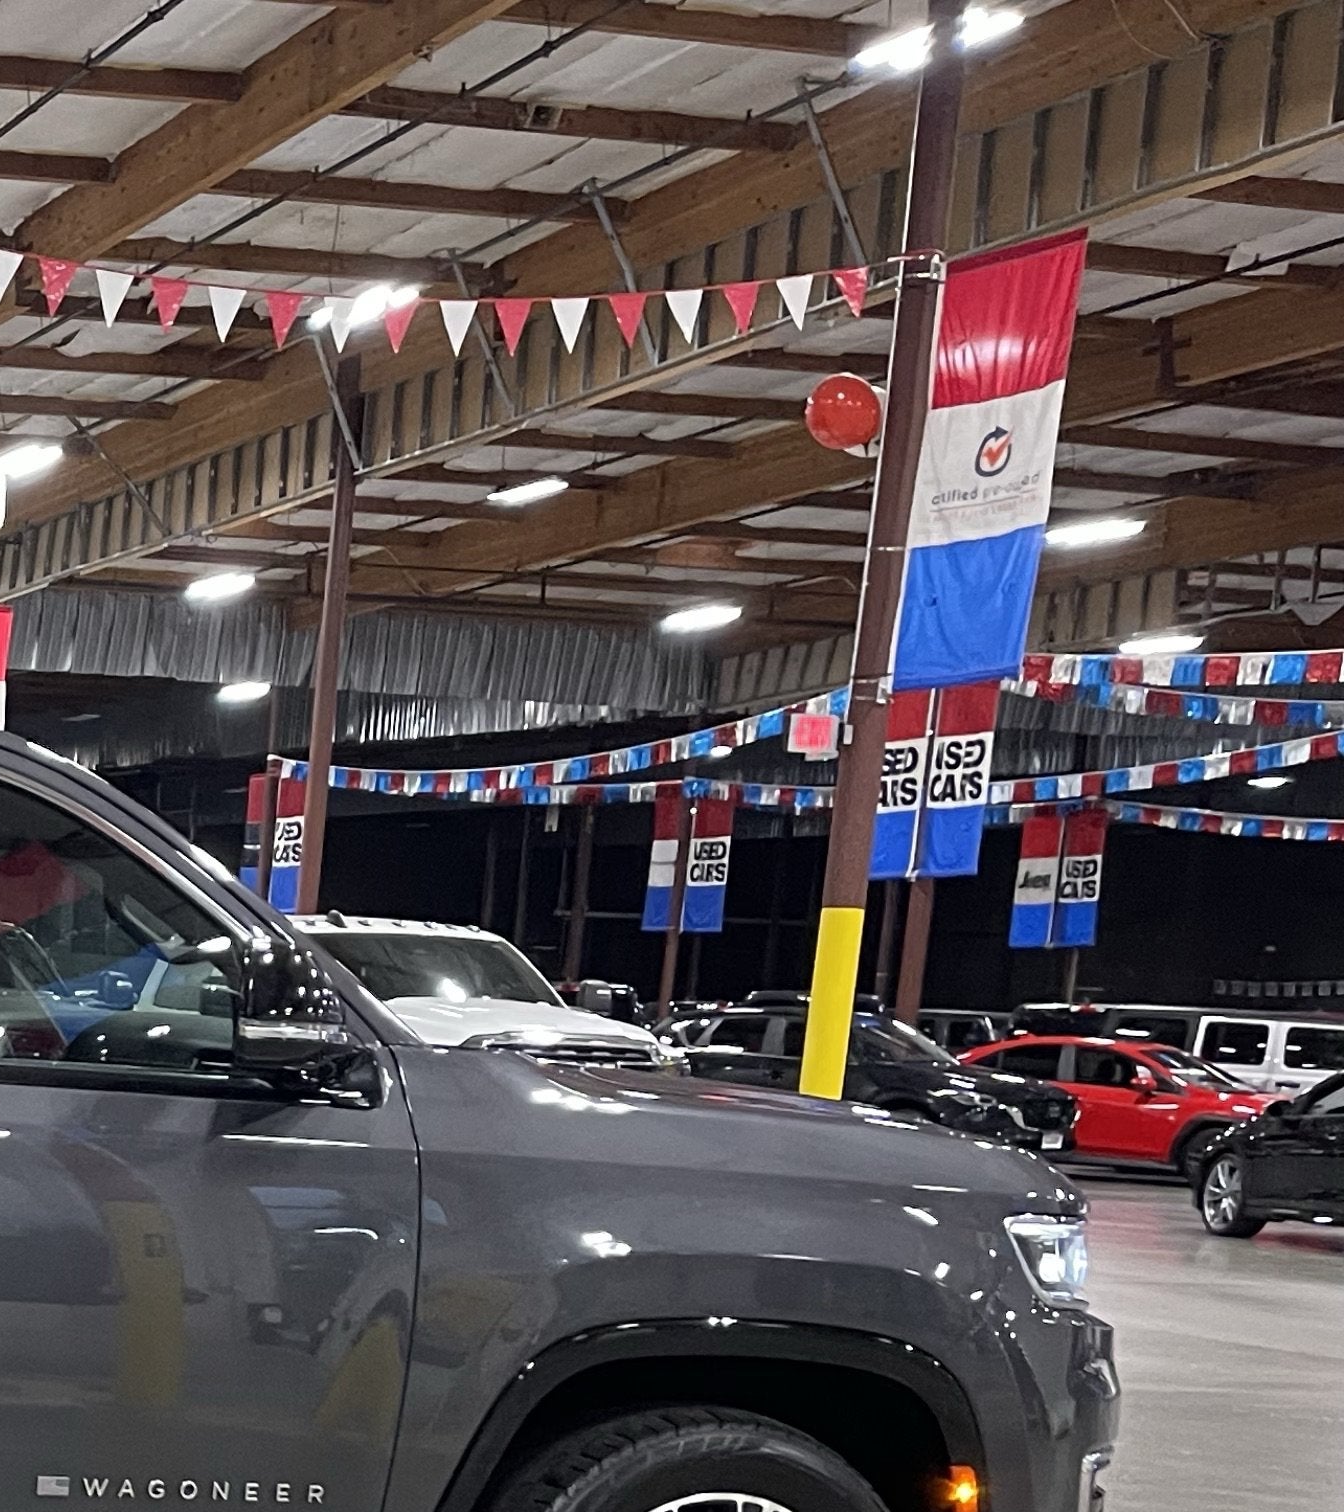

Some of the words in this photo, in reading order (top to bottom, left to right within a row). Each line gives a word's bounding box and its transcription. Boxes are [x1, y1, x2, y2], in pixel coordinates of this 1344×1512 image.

[882, 746, 919, 776] SED
[878, 777, 918, 807] ARS
[82, 1477, 325, 1504] WAGONEER
